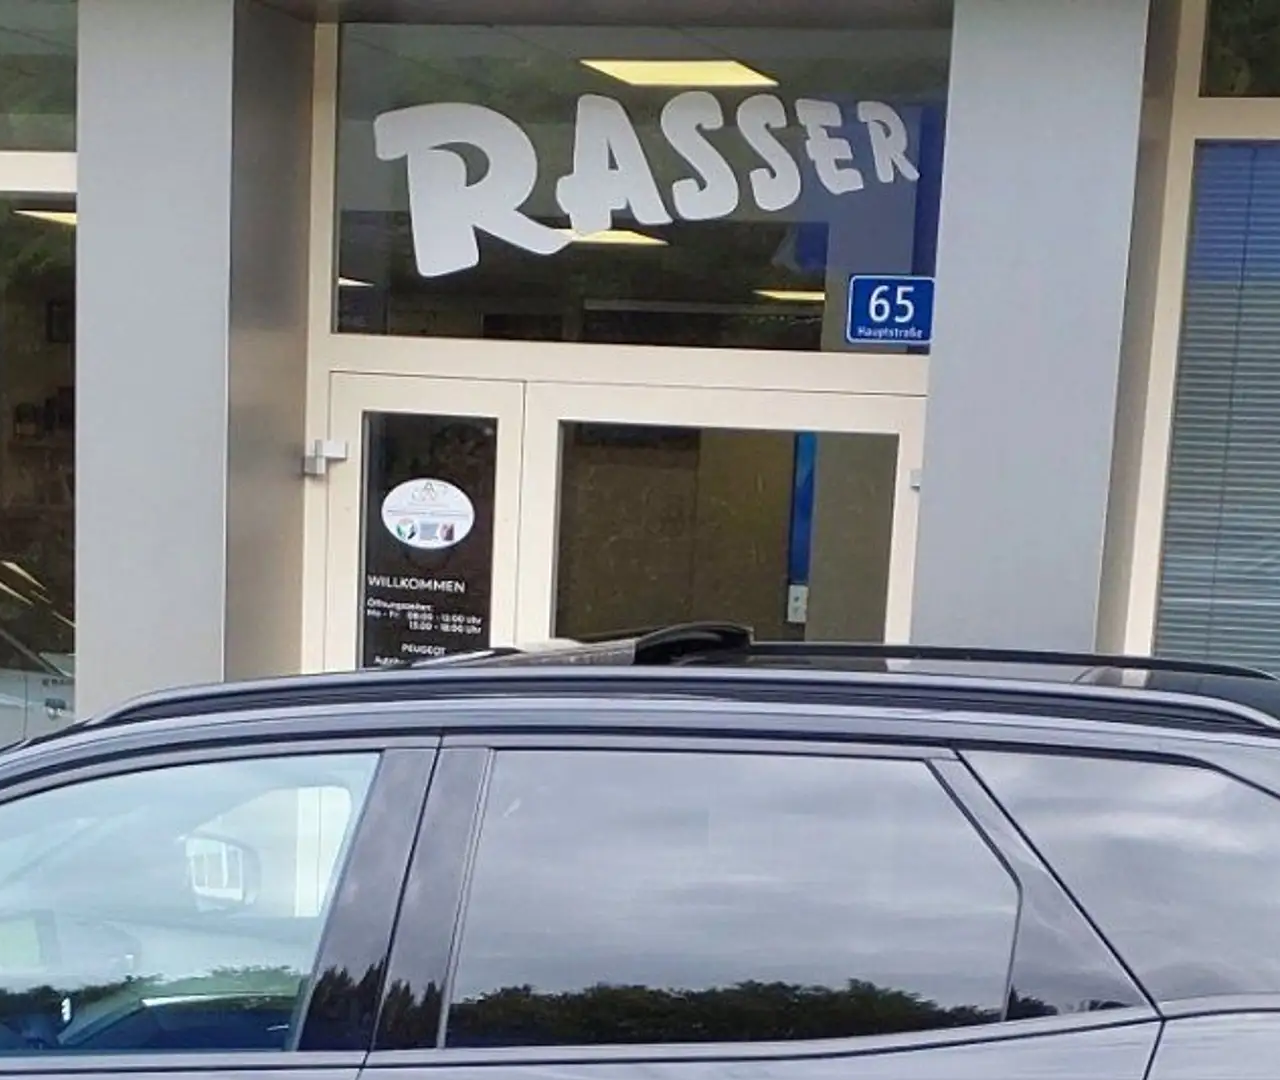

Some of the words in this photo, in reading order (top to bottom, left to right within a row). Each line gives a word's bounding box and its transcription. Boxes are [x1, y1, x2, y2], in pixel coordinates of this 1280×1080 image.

[373, 90, 921, 277] RASSER
[869, 285, 914, 323] 65
[856, 326, 924, 339] Hauptstraße
[367, 576, 466, 593] WILLKOMMEN
[401, 643, 446, 656] PEUGEOT
